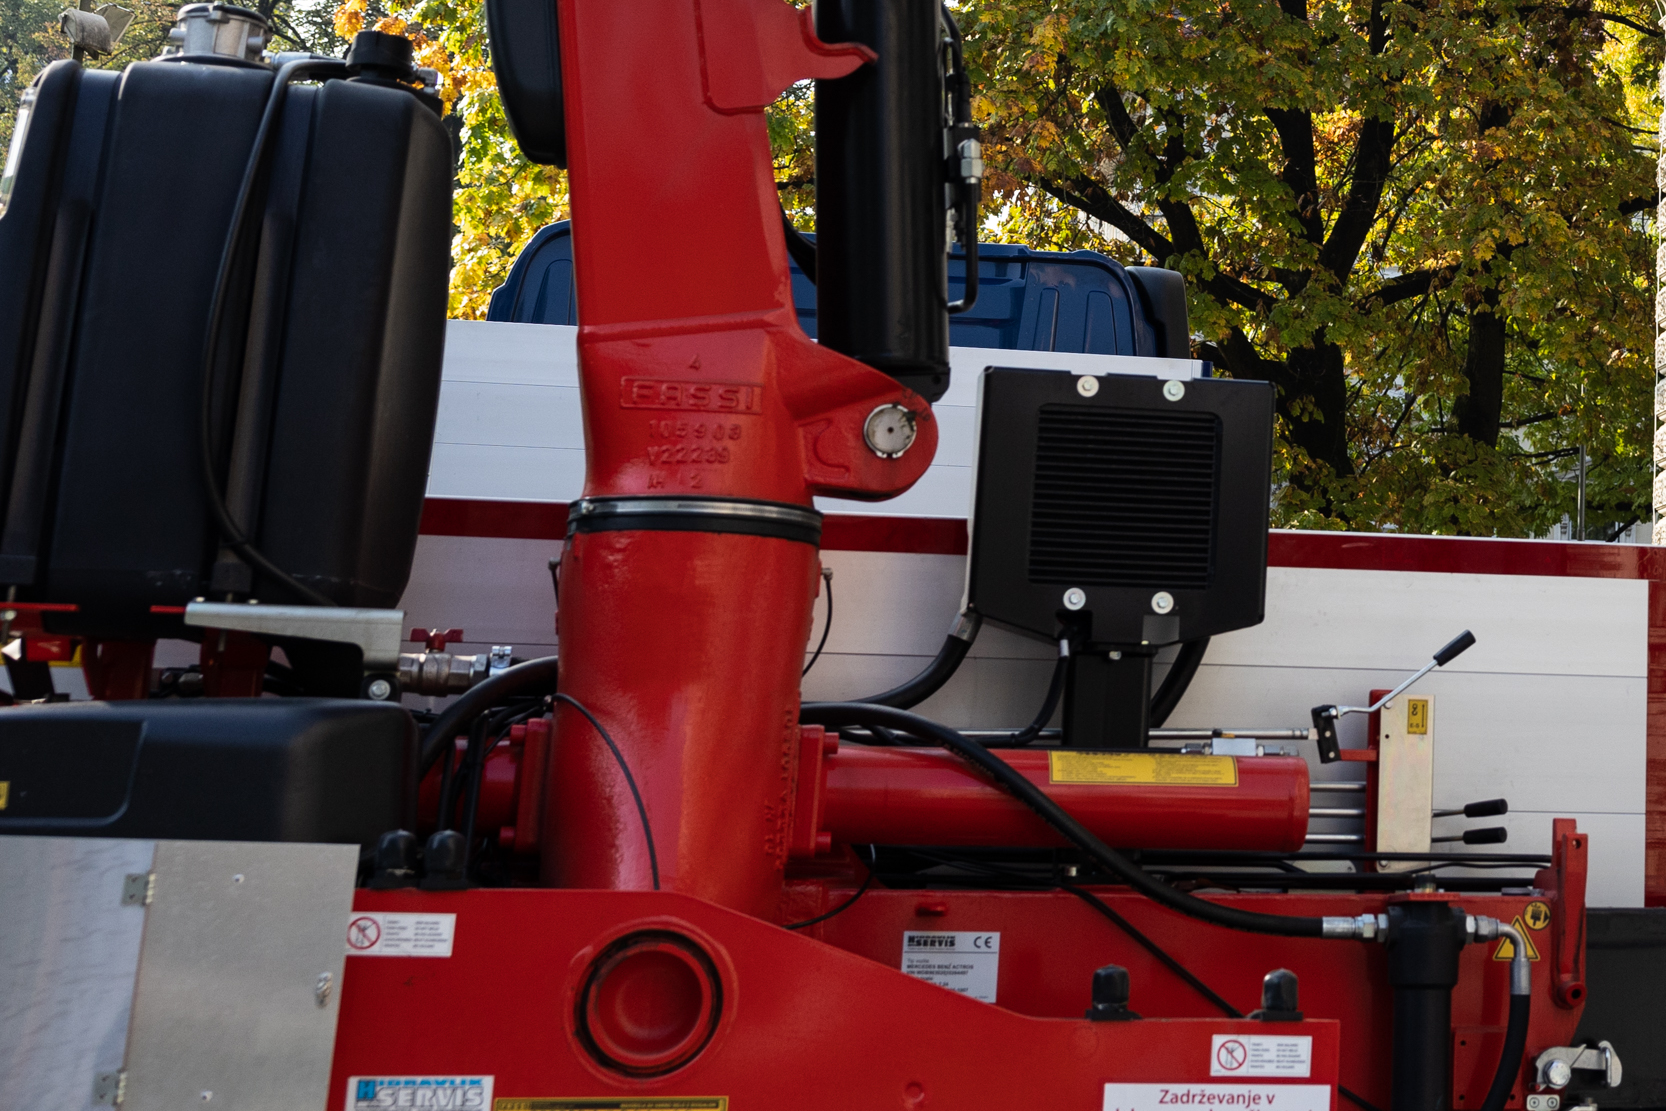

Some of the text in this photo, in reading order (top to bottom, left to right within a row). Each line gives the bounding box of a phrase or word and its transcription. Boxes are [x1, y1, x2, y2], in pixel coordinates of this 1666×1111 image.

[632, 381, 754, 410] FASSI
[1158, 1089, 1276, 1108] Zadrževanje v
